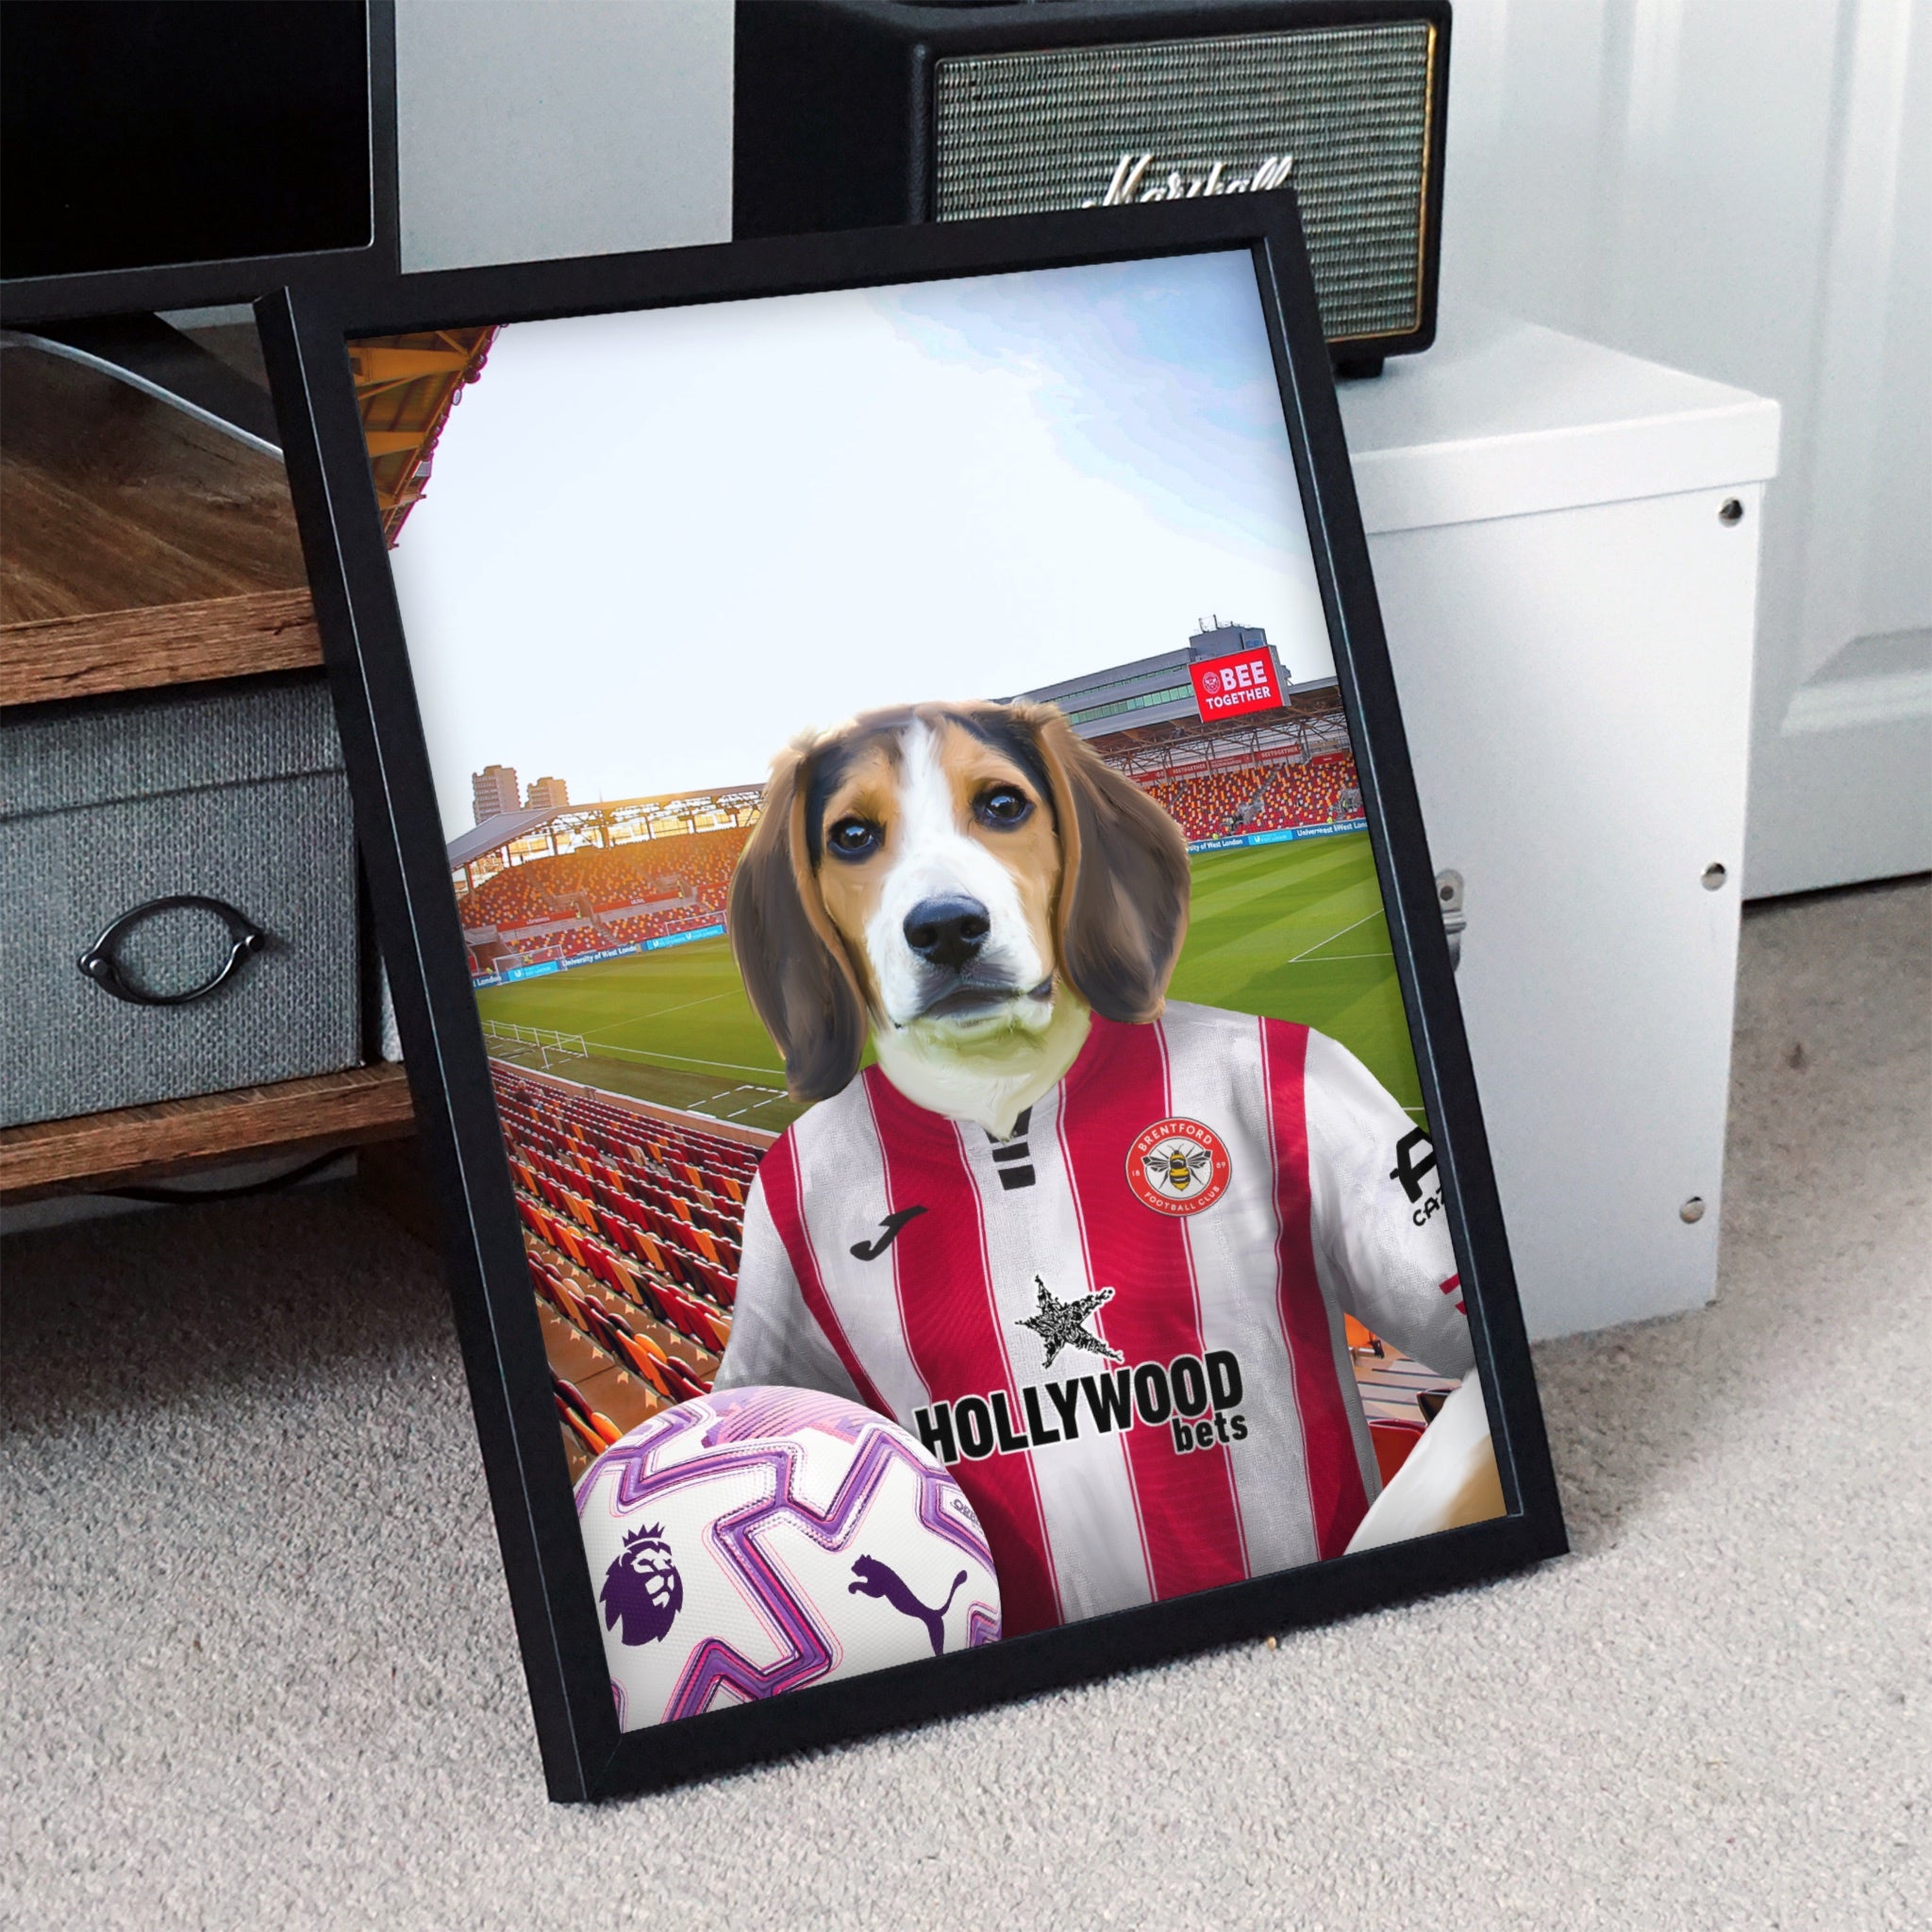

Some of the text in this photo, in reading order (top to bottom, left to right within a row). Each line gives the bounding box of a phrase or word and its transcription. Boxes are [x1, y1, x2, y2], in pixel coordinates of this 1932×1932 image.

[1219, 660, 1267, 691] BEE
[1206, 686, 1271, 709] TOGETHER
[1208, 841, 1221, 849] West
[1223, 839, 1243, 847] London
[1138, 1124, 1212, 1152] BRENTFORD
[1144, 1186, 1220, 1211] FOOTBALL CLUB
[913, 1348, 1244, 1464] HOLLYWOOD
[1171, 1413, 1248, 1453] bets
